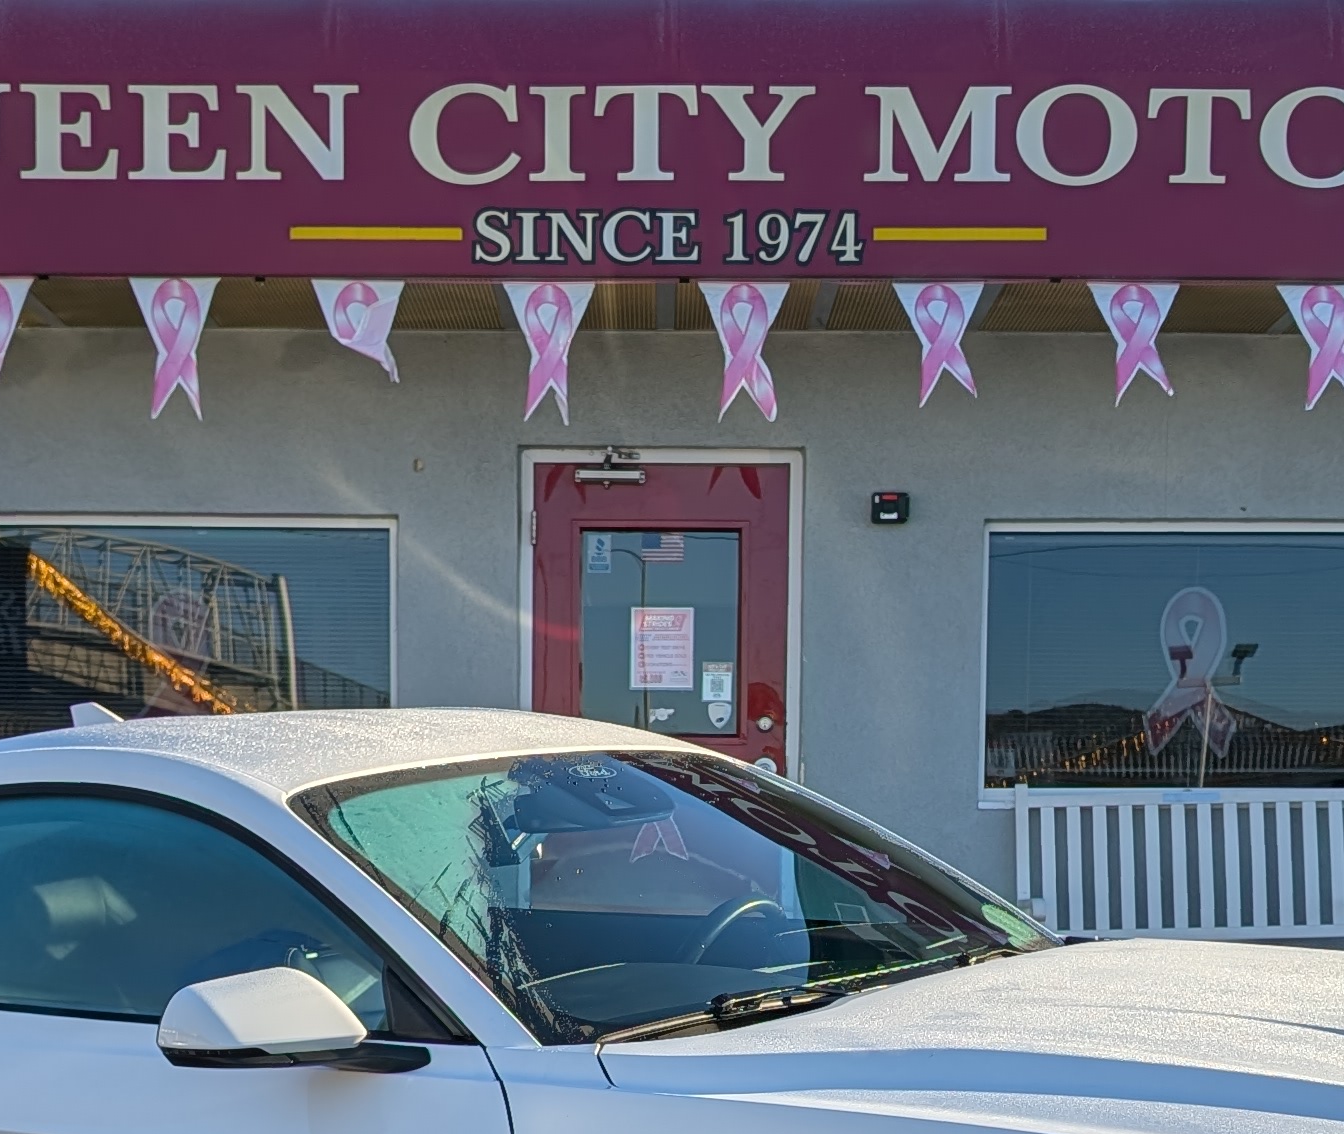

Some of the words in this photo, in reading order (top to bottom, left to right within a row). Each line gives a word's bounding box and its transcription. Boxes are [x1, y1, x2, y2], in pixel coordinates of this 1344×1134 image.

[408, 82, 816, 186] CITY
[472, 206, 700, 266] SINCE
[723, 208, 864, 266] 1974
